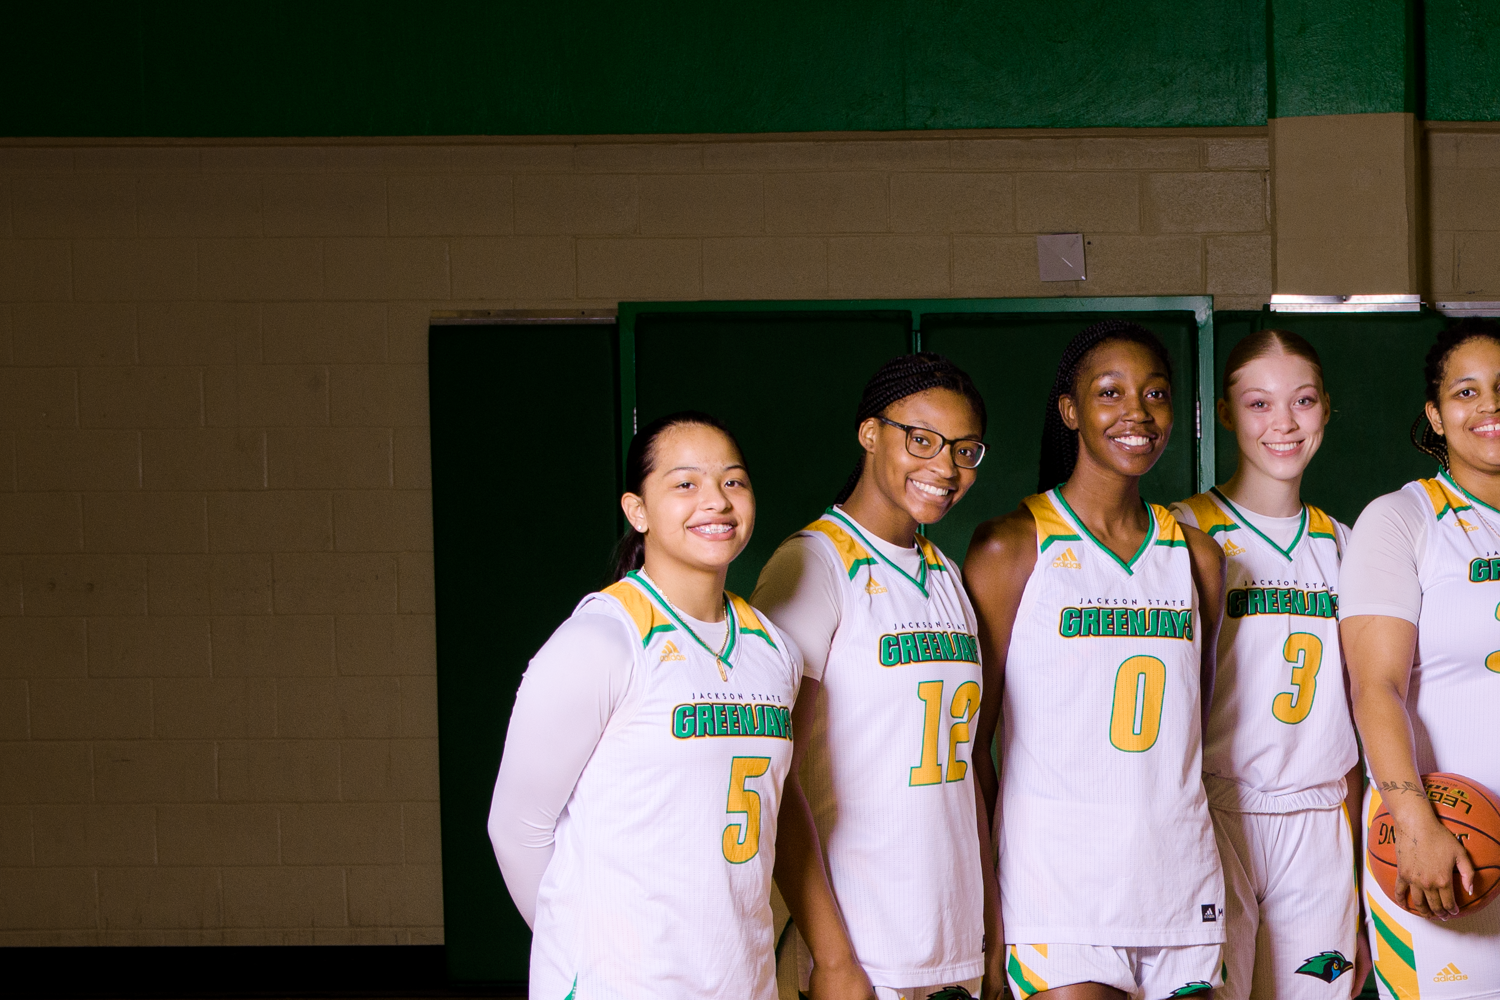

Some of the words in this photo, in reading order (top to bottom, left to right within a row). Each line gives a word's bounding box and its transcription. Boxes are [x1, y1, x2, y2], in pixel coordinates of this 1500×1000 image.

[1052, 560, 1082, 569] adidas
[894, 621, 942, 630] JACKSON
[692, 692, 743, 700] JACKSON
[752, 693, 782, 703] STATE
[1109, 654, 1166, 753] 0
[1271, 631, 1323, 725] 3
[908, 679, 981, 787] 12
[722, 756, 771, 865] 5
[1433, 973, 1469, 983] adidas
